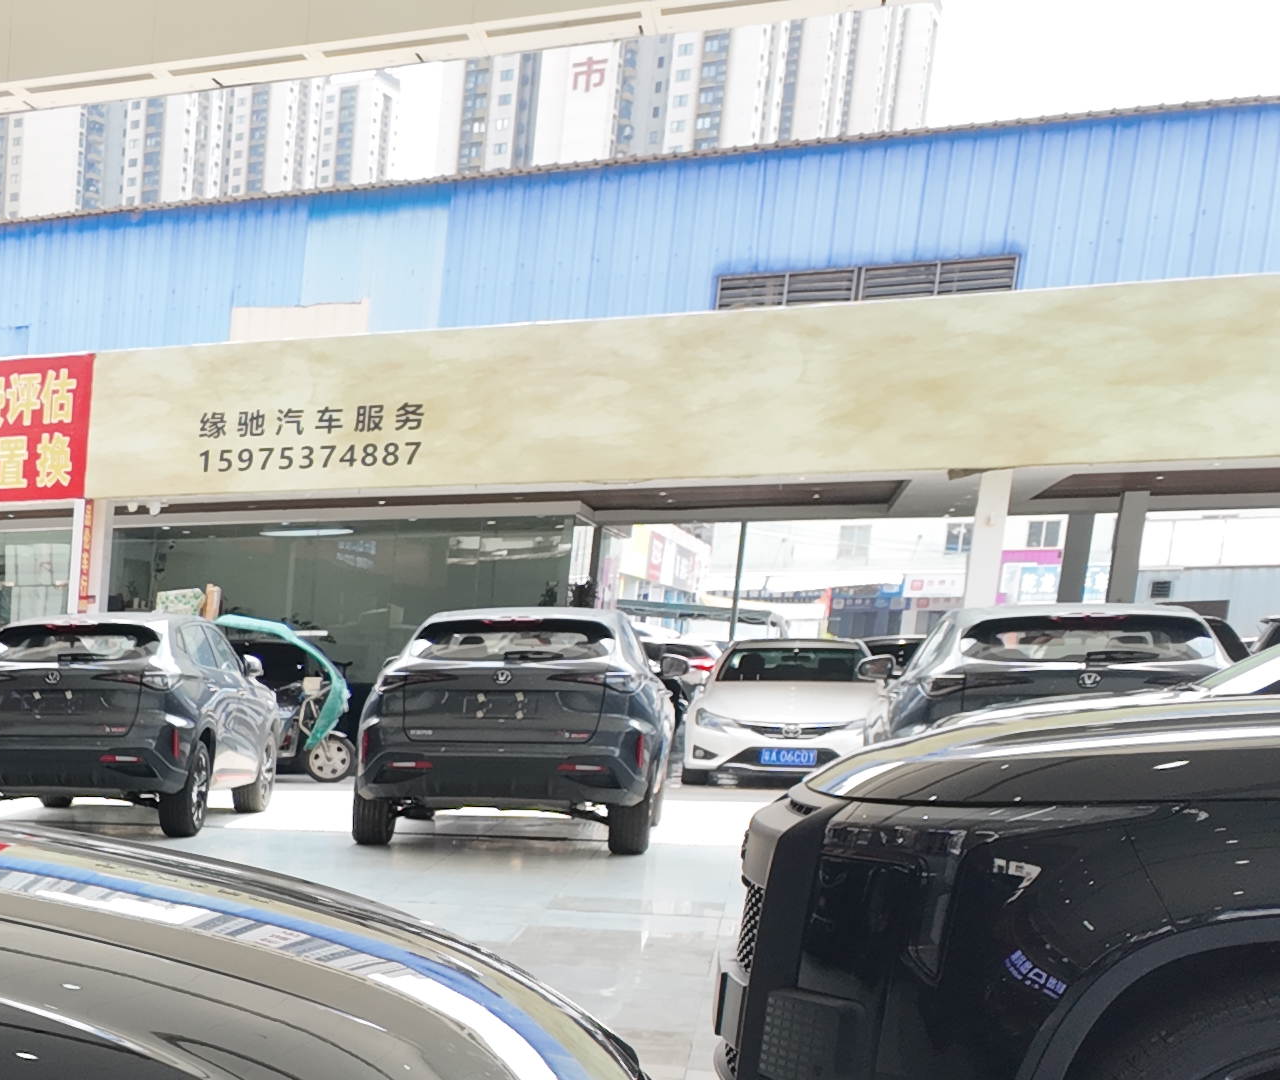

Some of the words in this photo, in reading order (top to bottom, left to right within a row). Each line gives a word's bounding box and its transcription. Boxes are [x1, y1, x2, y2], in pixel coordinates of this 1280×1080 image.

[572, 56, 609, 93] 市
[198, 401, 426, 441] 缘驰汽车服务
[198, 441, 423, 474] 15975374887
